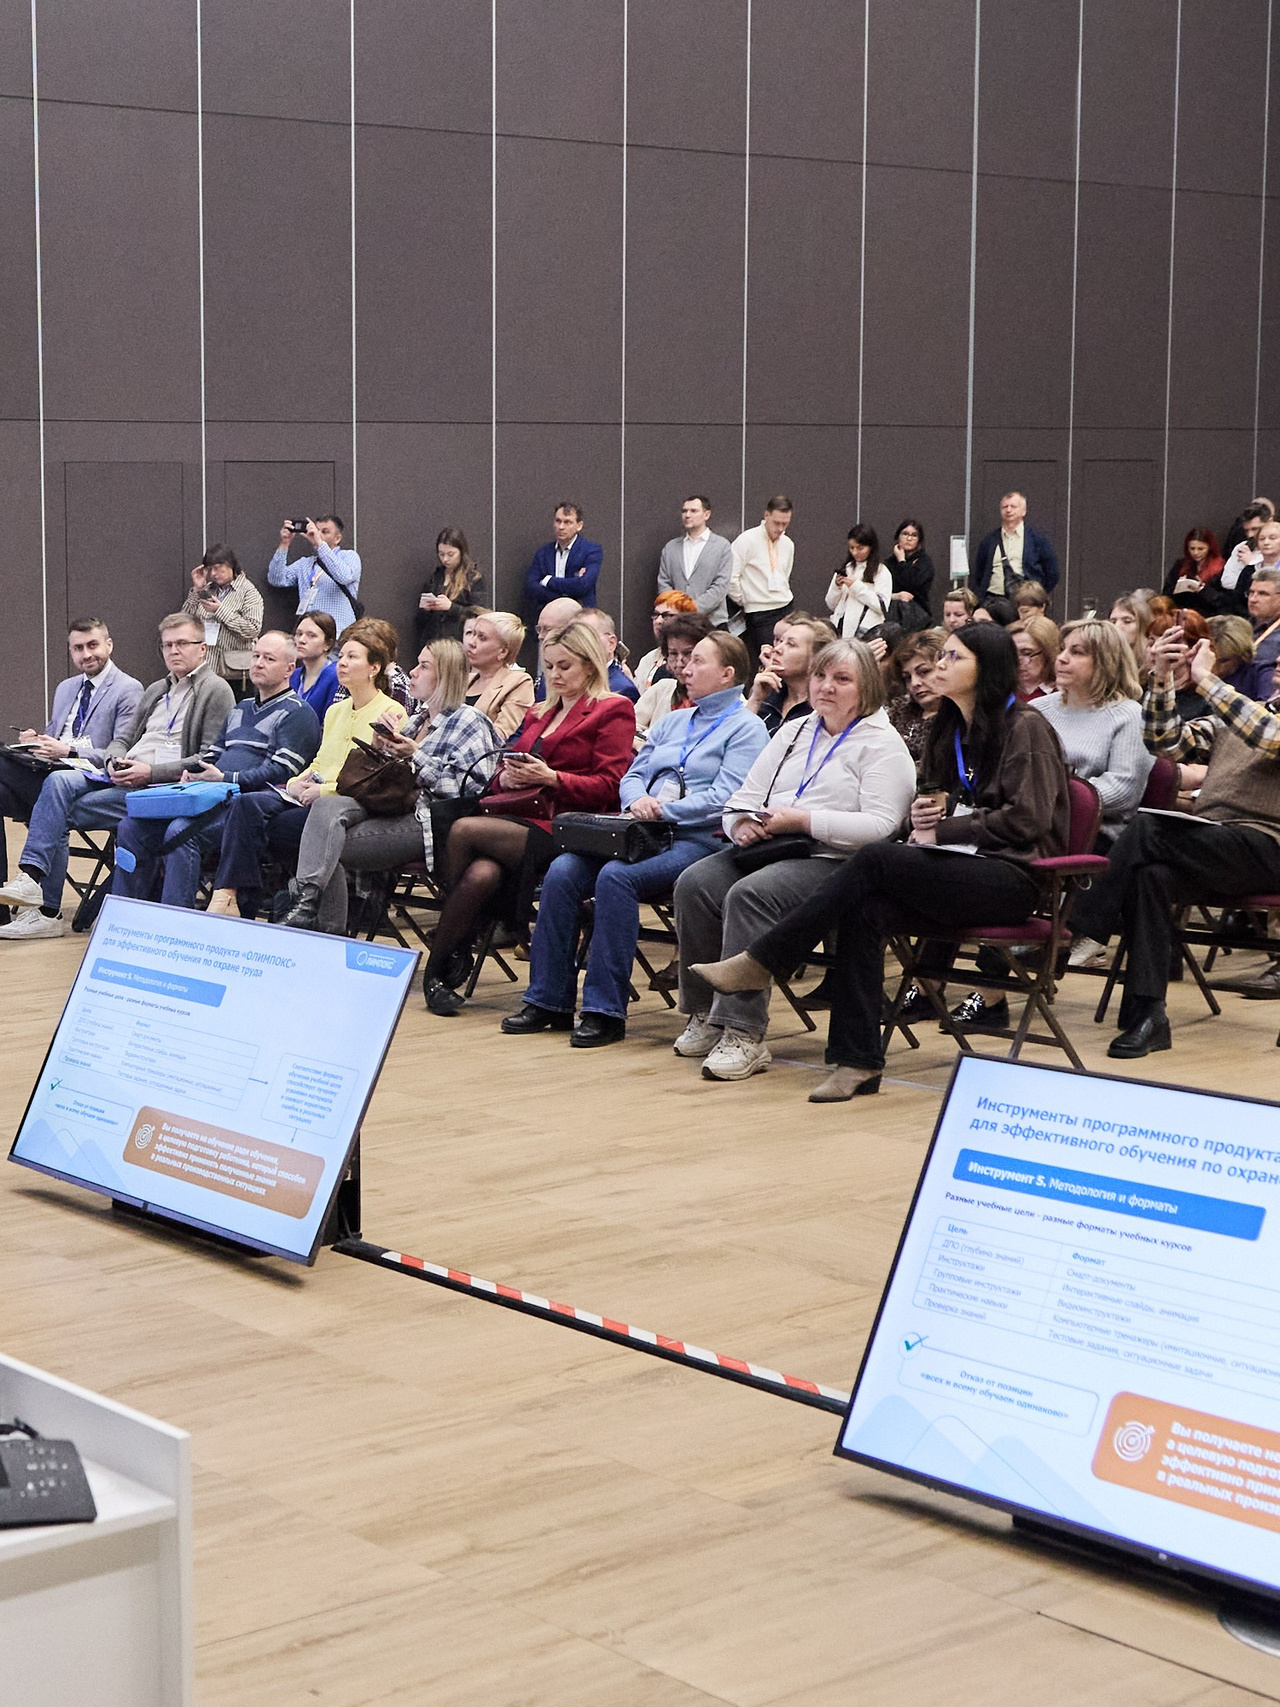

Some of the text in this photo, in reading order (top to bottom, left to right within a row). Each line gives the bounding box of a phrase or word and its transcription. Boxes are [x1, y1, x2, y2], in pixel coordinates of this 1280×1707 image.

[102, 937, 263, 977] для эффективного обучения по охране труда
[108, 923, 296, 969] Инструменты программного продукта «ОЛИМПОКС»
[976, 1096, 1280, 1164] Инструменты программного продукта
[970, 1118, 1280, 1185] для эффективного обучения по охран
[968, 1161, 1035, 1185] Инструмент
[1049, 1178, 1116, 1202] Методология
[1119, 1193, 1126, 1203] и
[1128, 1193, 1178, 1214] форматы
[945, 1192, 975, 1205] Разные
[977, 1200, 1012, 1214] учебные
[1014, 1208, 1035, 1218] цели
[1042, 1214, 1074, 1227] разные
[1076, 1221, 1118, 1236] форматы
[1119, 1231, 1157, 1244] учебных
[1161, 1240, 1192, 1252] курсов
[947, 1223, 968, 1235] Цель
[942, 1239, 959, 1250] ДПО
[1072, 1252, 1106, 1266] Формат
[938, 1254, 985, 1271] Инструктажи
[920, 1372, 943, 1384] «всех
[953, 1382, 977, 1395] всему
[979, 1388, 1014, 1404] обучаем
[1016, 1399, 1069, 1418] одинаково»
[960, 1370, 1033, 1397] Отказ от позиции
[1166, 1439, 1175, 1450] а
[1177, 1442, 1236, 1467] целевую
[1171, 1421, 1191, 1438] Вы
[1192, 1429, 1262, 1457] получаете
[1156, 1469, 1166, 1482] в
[1167, 1473, 1233, 1502] реальных
[1161, 1454, 1244, 1487] эффективно
